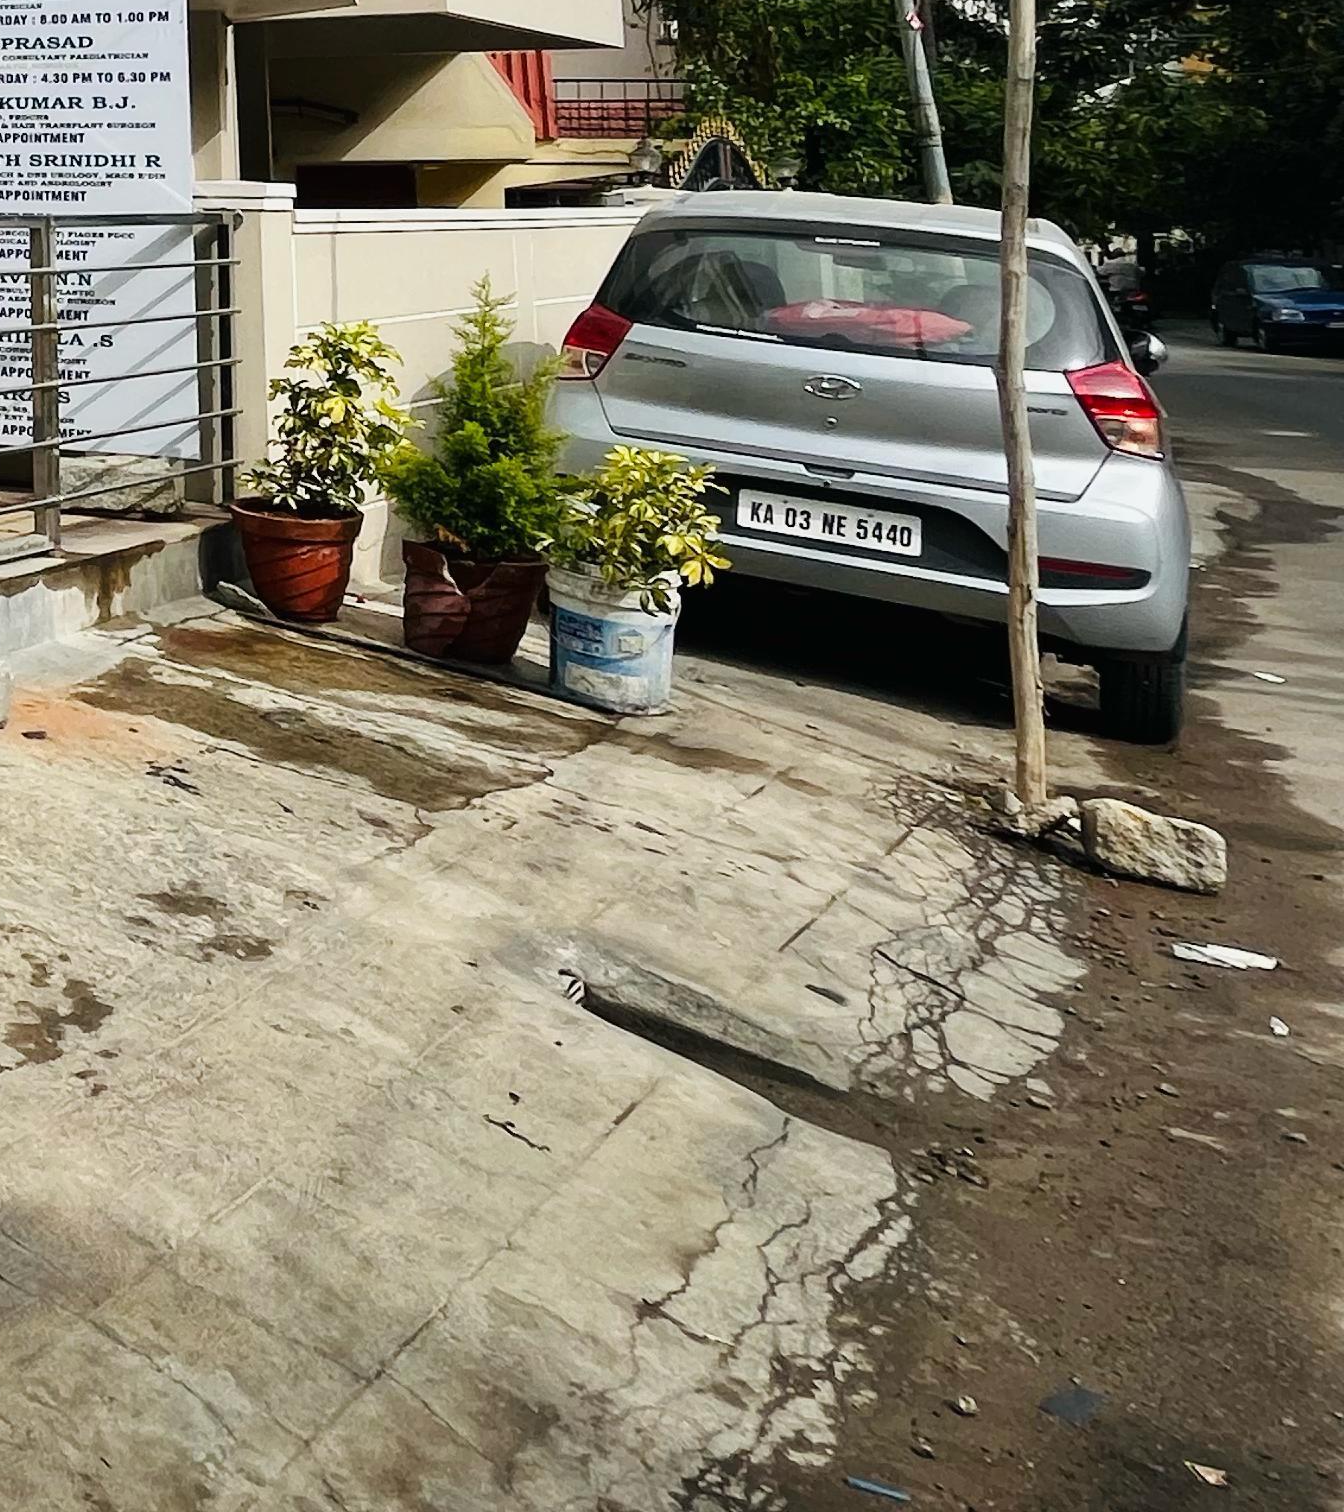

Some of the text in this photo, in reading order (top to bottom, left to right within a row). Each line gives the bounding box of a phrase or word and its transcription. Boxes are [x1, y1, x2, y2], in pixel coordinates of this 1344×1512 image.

[1, 36, 94, 50] PRASAD
[29, 154, 136, 168] SRINIDHI
[750, 502, 912, 548] KA 03 NE 5440
